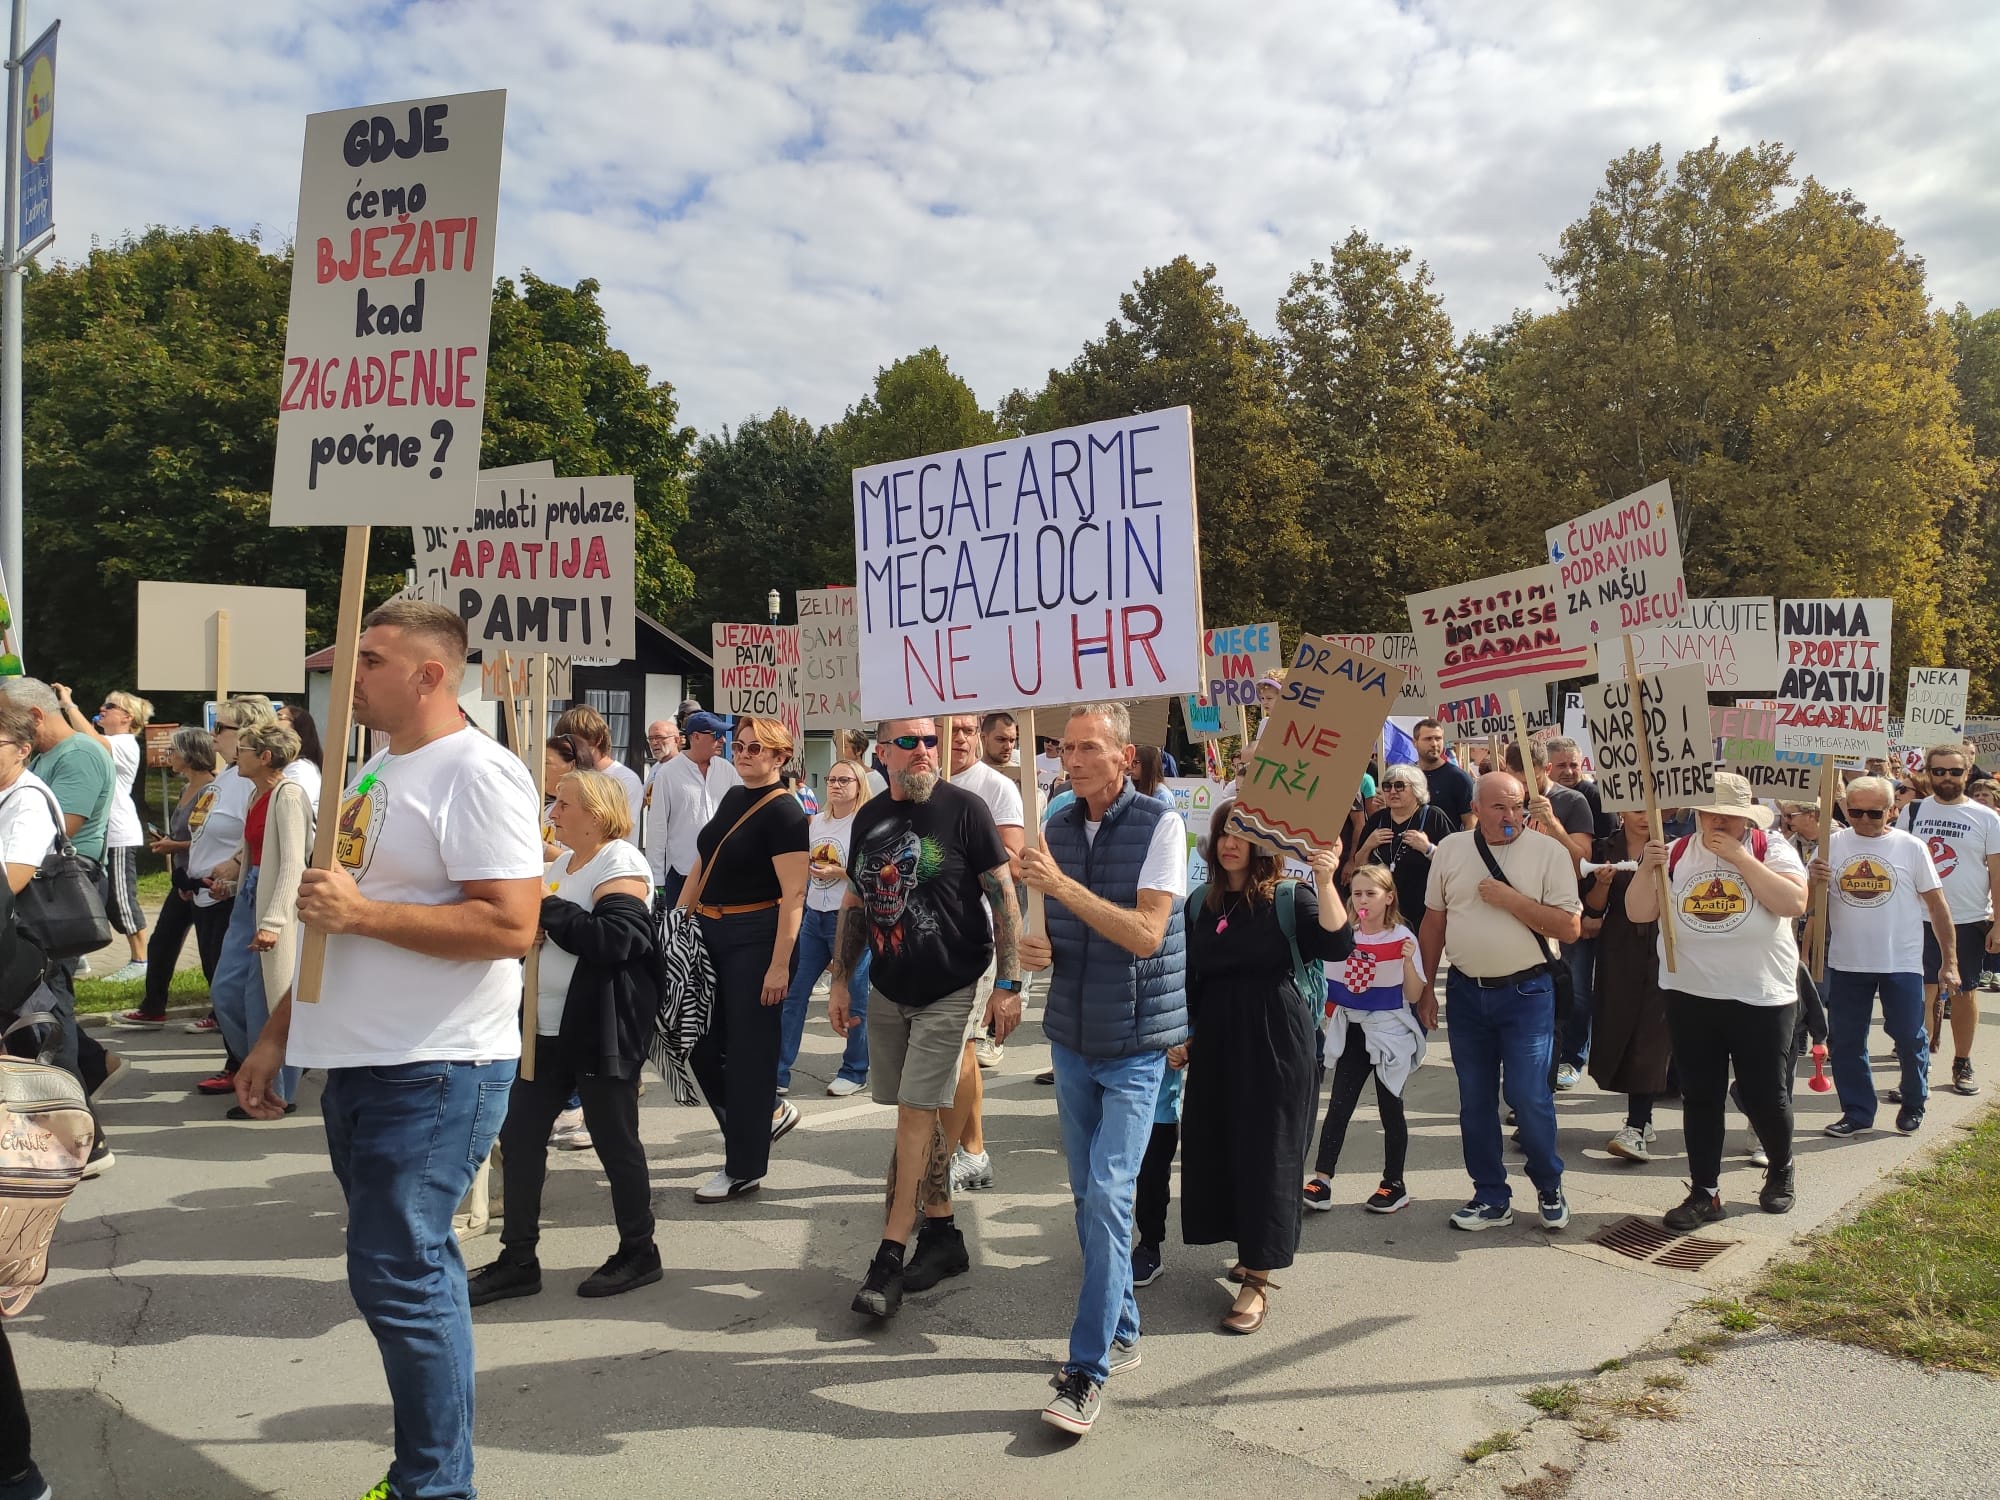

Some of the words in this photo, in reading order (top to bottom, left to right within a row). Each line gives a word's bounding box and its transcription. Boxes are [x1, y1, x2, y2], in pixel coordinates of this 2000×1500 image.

[343, 103, 450, 168] GDJE
[346, 178, 427, 221] ćemo
[316, 213, 479, 284] BJEŽATI
[354, 277, 425, 339] kad
[281, 346, 478, 412] ZAGAĐENJE
[860, 425, 1163, 552] MEGAFARME
[454, 487, 537, 534] andati
[545, 485, 630, 541] prolaze,
[1567, 499, 1651, 557] ČUVAJMO
[450, 535, 612, 580] APATIJA
[864, 514, 1164, 634] MEGAZLOČIN
[1560, 527, 1668, 590] PODRAVINU
[1567, 589, 1592, 616] ZA
[1598, 566, 1647, 606] NAŠU
[1619, 576, 1685, 629] DJECU!
[459, 587, 613, 648] PAMTI!
[1783, 601, 1871, 638] NJIMA
[903, 624, 978, 706] NE
[1007, 618, 1042, 696] U
[1070, 604, 1168, 690] HR
[1222, 653, 1256, 680] IM
[1382, 635, 1419, 660] OTPA
[1661, 633, 1737, 661] NAMA
[1294, 642, 1387, 698] DRAVA
[1777, 667, 1886, 706] APATIJI
[1917, 670, 1959, 687] NEKA
[729, 689, 778, 715] UZGO
[1210, 678, 1262, 706] PRO
[1281, 681, 1326, 710] SE
[1437, 692, 1502, 724] APATIJA
[1603, 675, 1664, 710] ČUAJ
[1457, 717, 1479, 739] NE
[1682, 704, 1688, 733] I
[1775, 702, 1889, 734] ZAGAĐENJE
[1911, 706, 1956, 727] BUDE
[1281, 719, 1343, 758] NE
[1598, 734, 1675, 770] OKOIŠ,
[1681, 737, 1695, 761] A
[1252, 755, 1321, 802] TRŽI
[1601, 772, 1625, 801] NE
[1846, 879, 1884, 891] Apatija
[1692, 900, 1737, 912] Apatija
